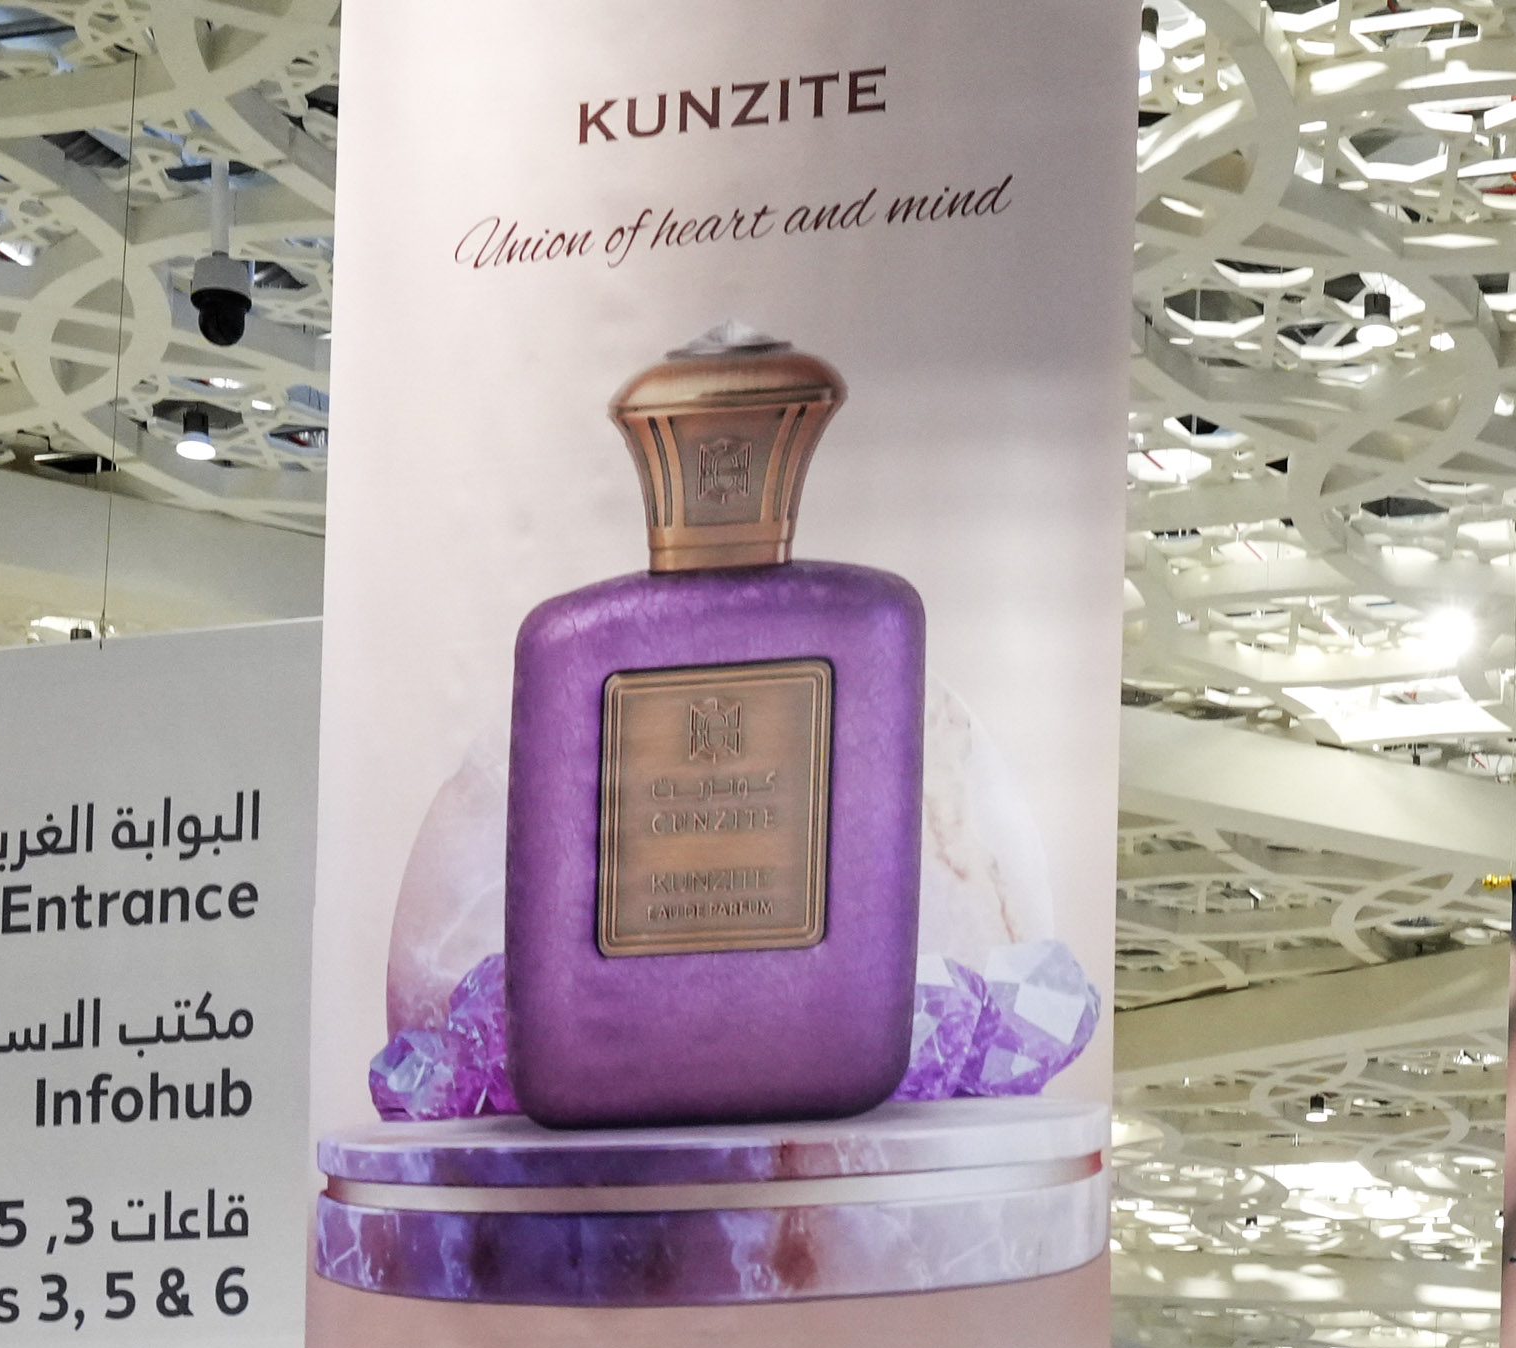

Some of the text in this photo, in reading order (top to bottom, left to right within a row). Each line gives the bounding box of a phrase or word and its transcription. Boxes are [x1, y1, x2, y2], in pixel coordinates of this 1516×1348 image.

[578, 66, 886, 145] KUNZITE
[454, 174, 1014, 269] Union of heart and mind
[111, 789, 260, 861] البوابة
[1, 880, 259, 934] Entrance
[119, 991, 254, 1058] مكتب
[35, 1067, 253, 1127] Infohub
[111, 1188, 249, 1242] قاعات
[104, 1271, 136, 1320] 5
[155, 1267, 194, 1318] &
[215, 1266, 249, 1316] 6
